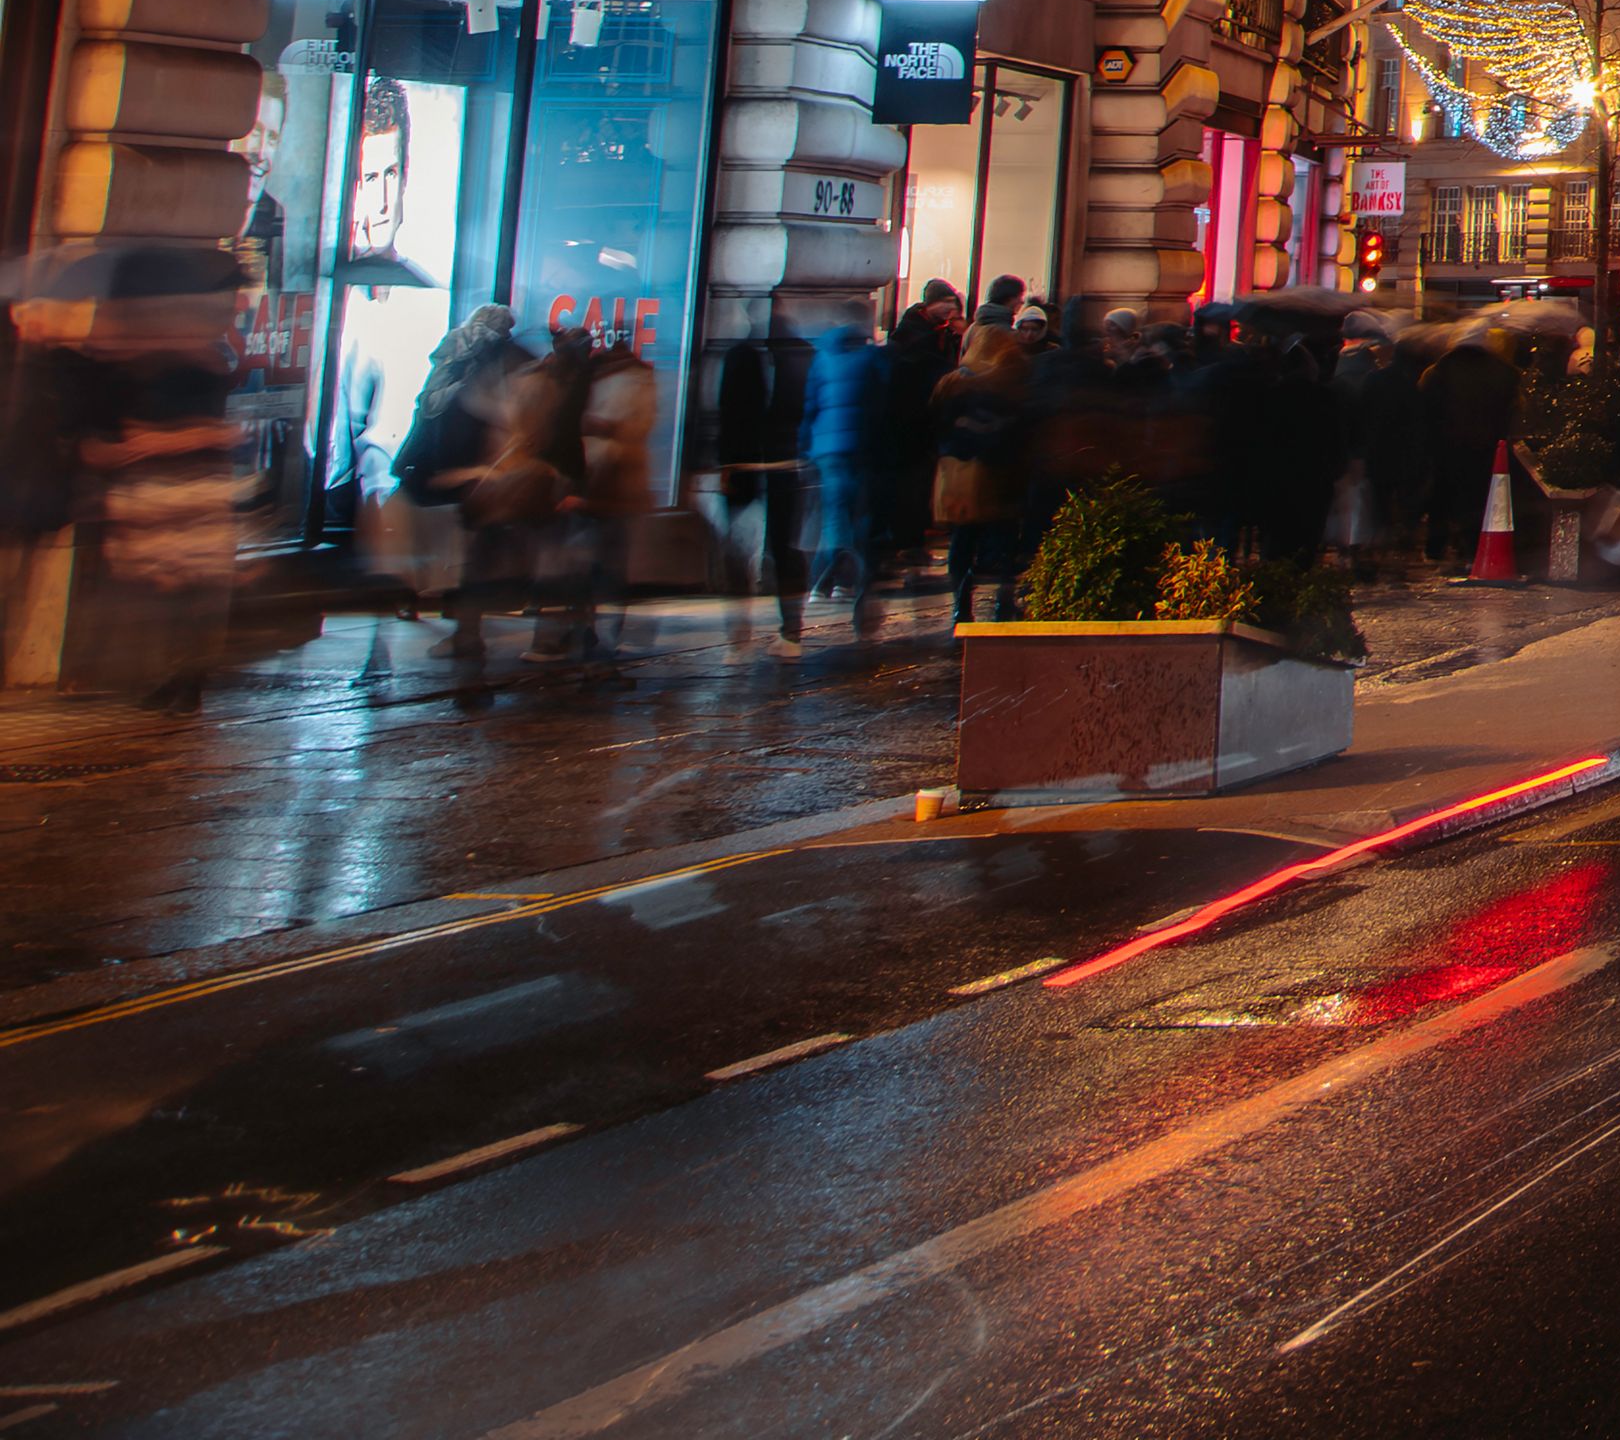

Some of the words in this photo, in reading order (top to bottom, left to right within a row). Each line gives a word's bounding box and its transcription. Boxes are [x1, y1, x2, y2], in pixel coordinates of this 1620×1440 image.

[908, 42, 939, 54] THE
[884, 54, 937, 67] NORTH
[897, 67, 937, 79] FACE
[1371, 169, 1385, 179] THE
[1364, 181, 1379, 190] ART
[1380, 180, 1391, 190] OF
[1352, 191, 1403, 211] BANKSY
